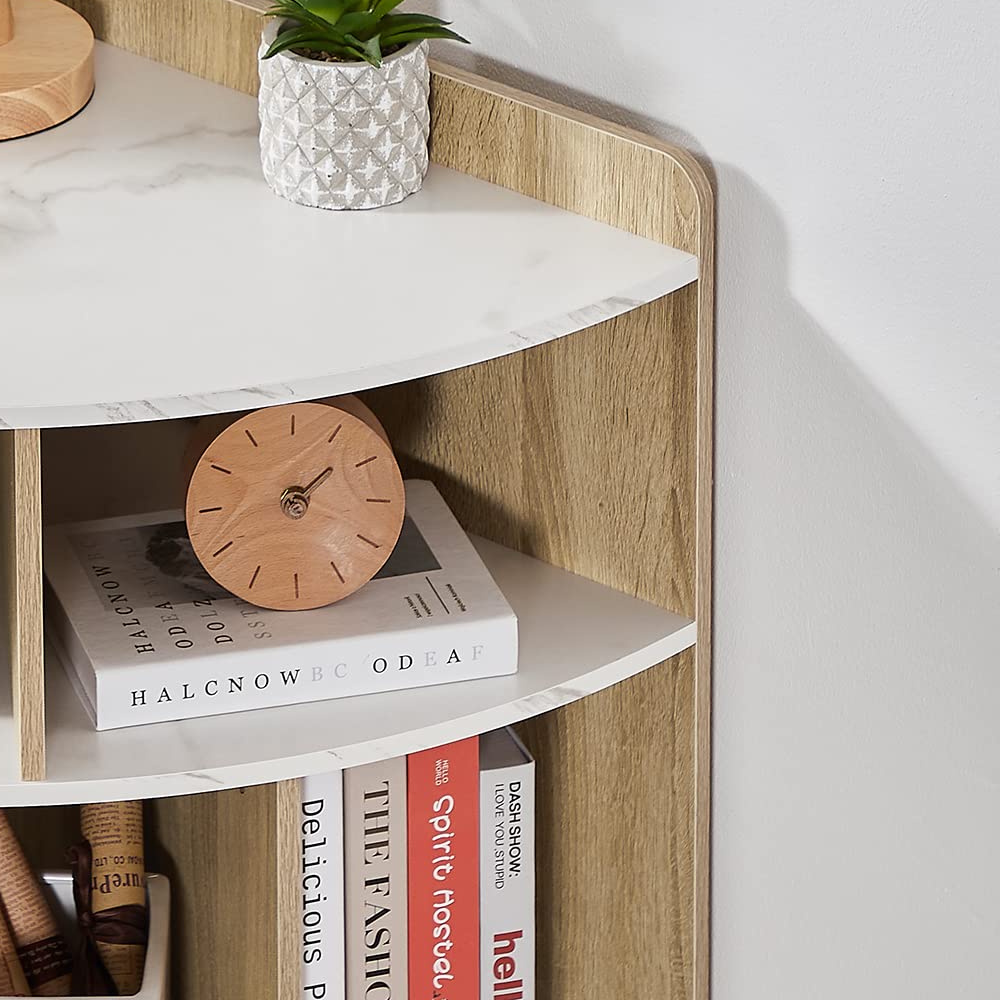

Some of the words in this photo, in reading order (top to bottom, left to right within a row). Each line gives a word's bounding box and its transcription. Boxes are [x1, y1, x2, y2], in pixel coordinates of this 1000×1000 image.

[435, 759, 443, 786] WORLD
[364, 781, 390, 865] THE
[495, 788, 504, 818] LOVE
[509, 781, 521, 823] DASH
[428, 794, 456, 882] Spirit
[495, 821, 505, 846] YOU
[509, 826, 521, 878] SHOW:
[301, 799, 327, 964] Delicious
[432, 889, 455, 990] Hostel
